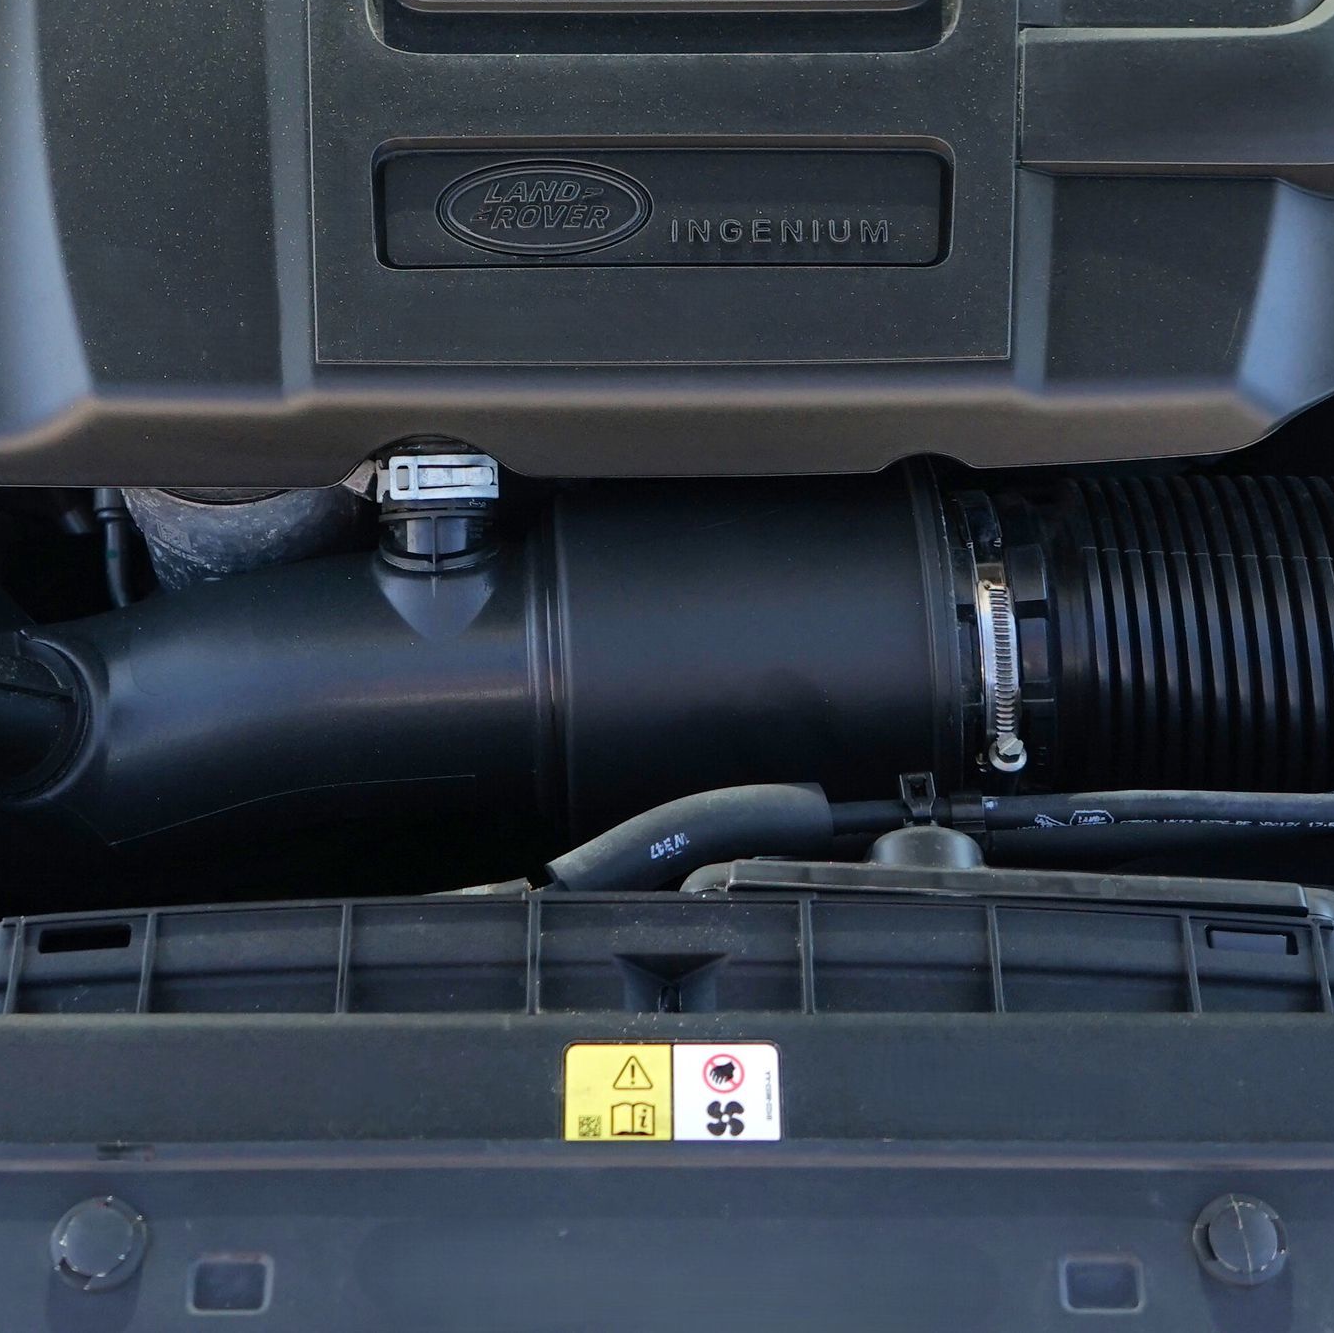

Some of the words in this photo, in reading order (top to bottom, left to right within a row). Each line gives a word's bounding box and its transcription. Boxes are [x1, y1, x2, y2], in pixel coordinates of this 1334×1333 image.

[484, 180, 579, 203] LAND
[494, 205, 609, 229] ROVER
[671, 218, 890, 244] INGENIUM
